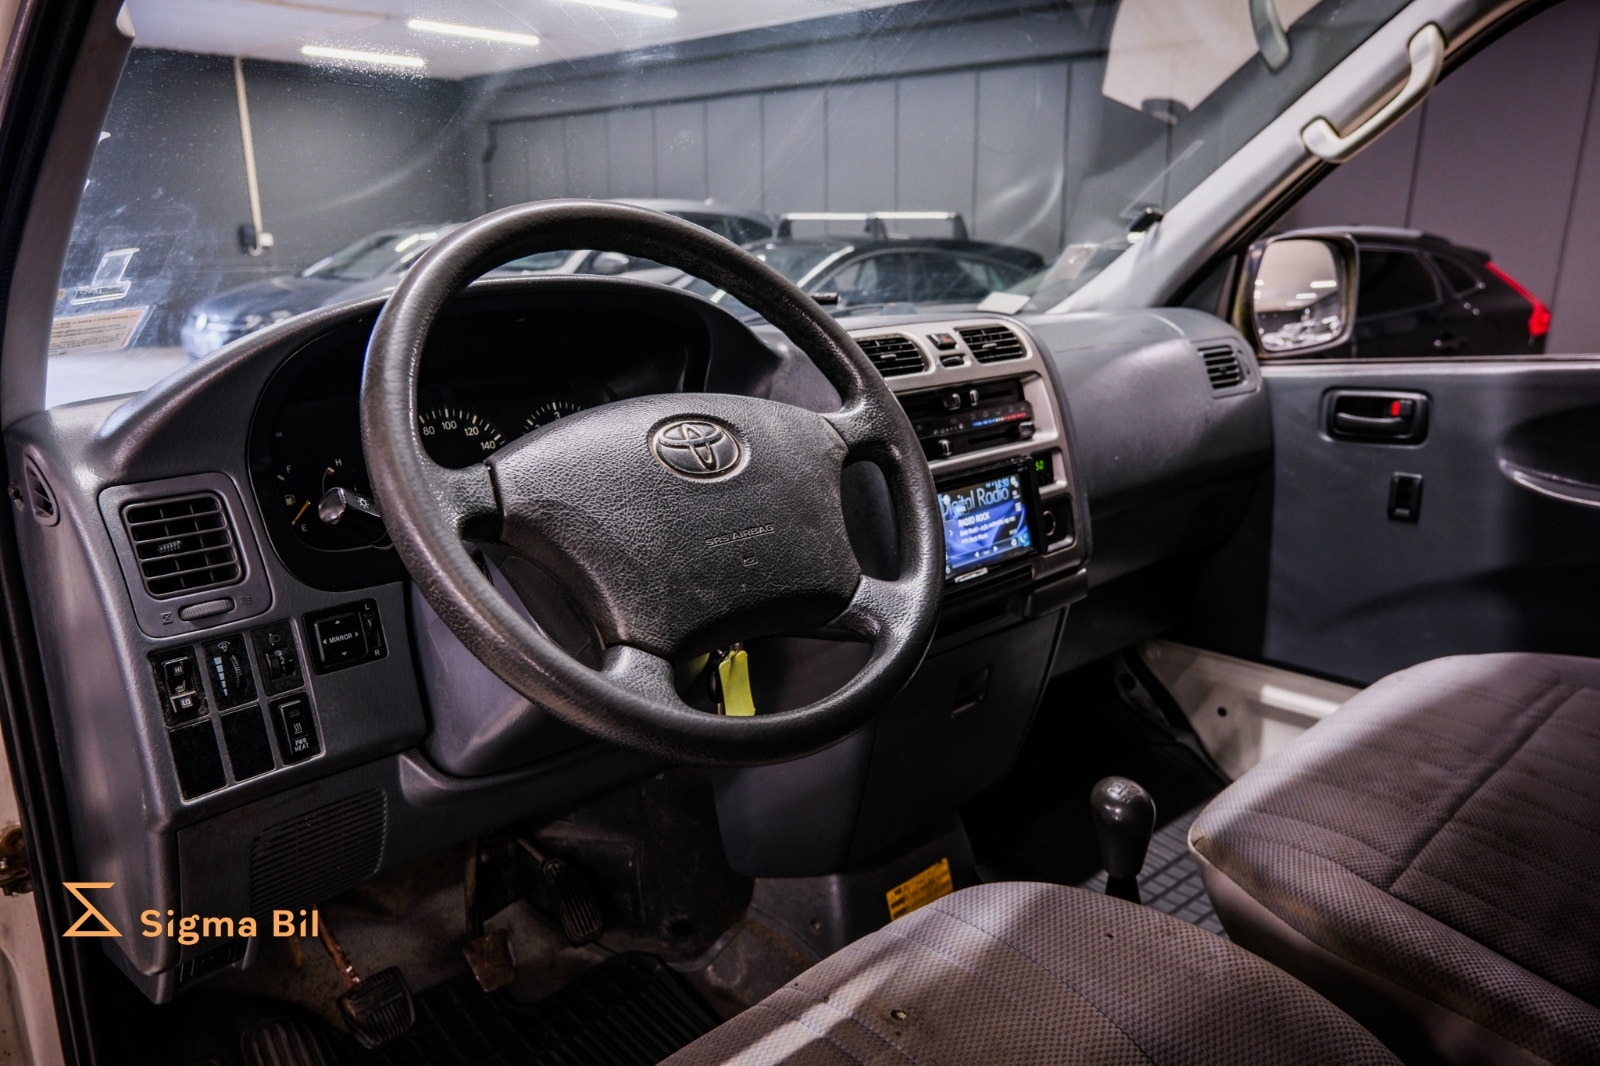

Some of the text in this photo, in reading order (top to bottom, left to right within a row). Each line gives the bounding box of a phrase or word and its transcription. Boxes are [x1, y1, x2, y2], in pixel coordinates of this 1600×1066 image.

[441, 420, 457, 430] 100
[422, 426, 435, 436] 80
[464, 426, 480, 436] 120
[480, 441, 496, 450] 140
[334, 458, 342, 466] H
[286, 465, 292, 473] F
[976, 486, 1010, 506] Radio
[976, 512, 990, 522] ROCK
[301, 524, 308, 532] E
[706, 524, 774, 546] SRS AIRBAG
[329, 632, 353, 644] MIRROR
[294, 738, 307, 746] PWR
[294, 742, 308, 752] HEAT
